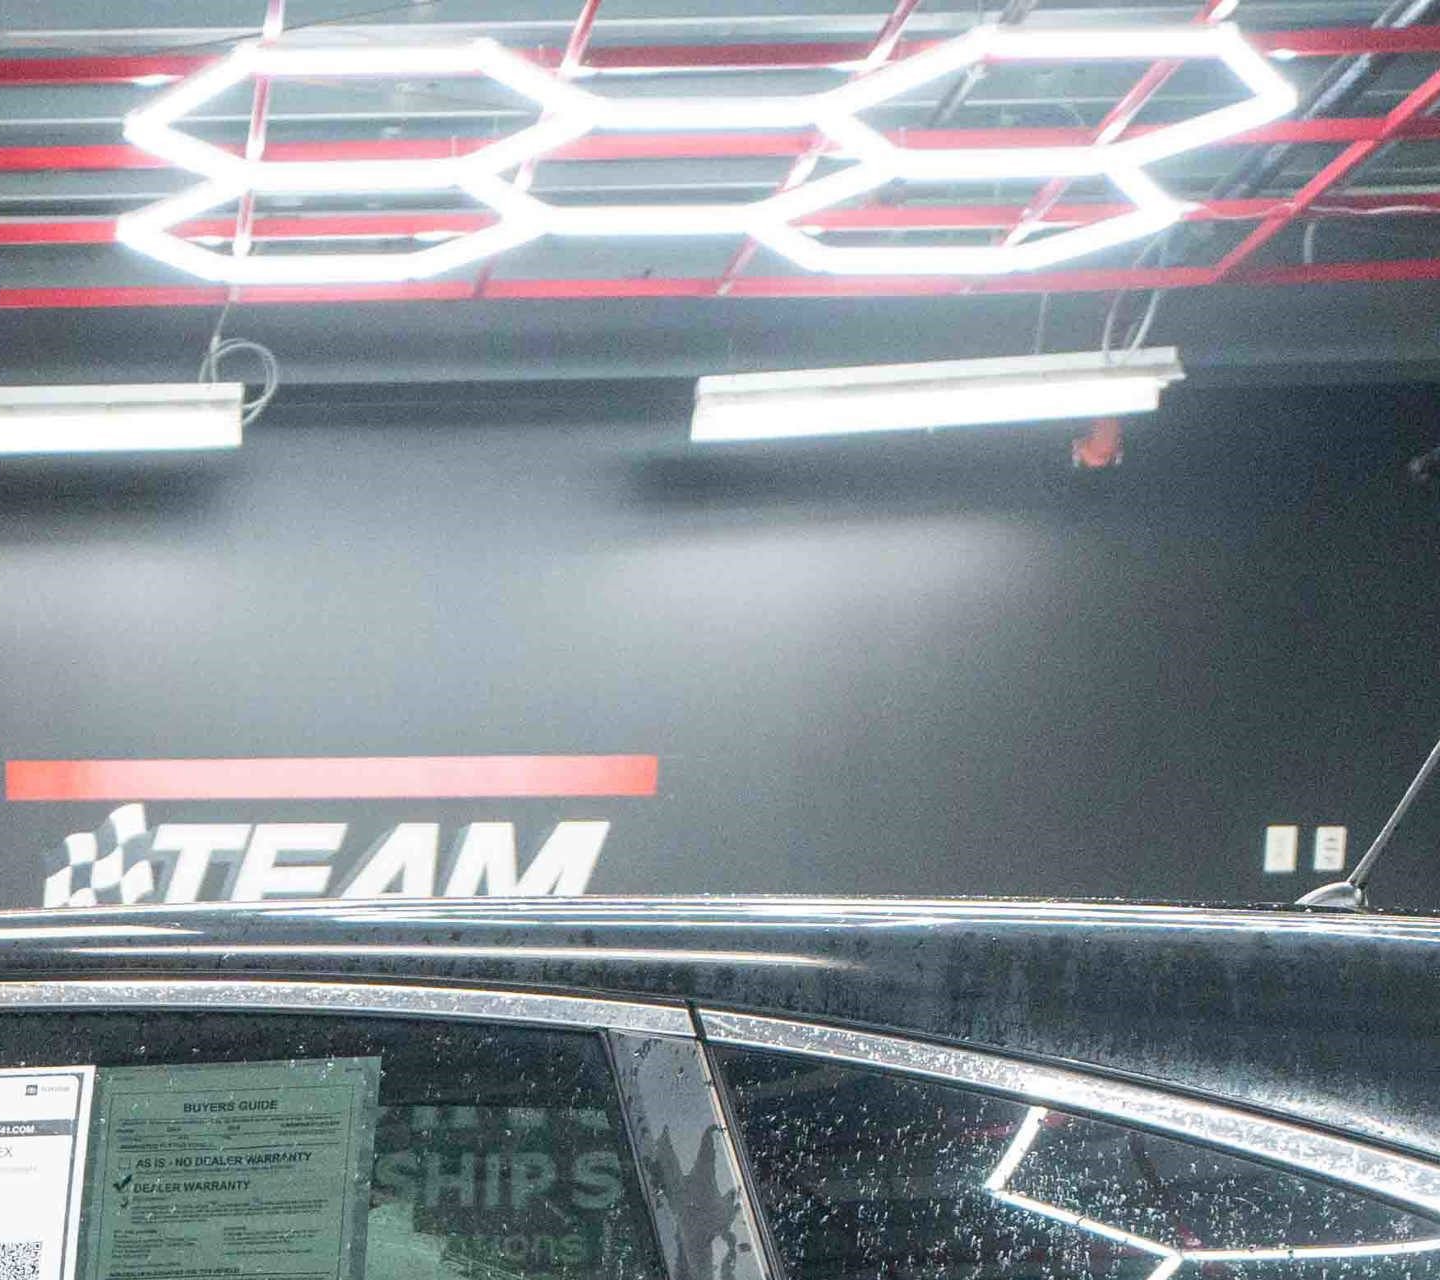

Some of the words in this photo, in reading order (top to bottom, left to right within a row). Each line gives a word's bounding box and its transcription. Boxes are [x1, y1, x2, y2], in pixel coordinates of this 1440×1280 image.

[152, 821, 610, 903] TEAM
[183, 1101, 234, 1113] BUYERS
[238, 1100, 278, 1112] GUIDE
[135, 1158, 151, 1169] AS
[154, 1158, 166, 1168] IS
[175, 1157, 192, 1168] NO
[195, 1155, 242, 1167] DEALER
[246, 1152, 312, 1165] WARRANTY
[134, 1183, 180, 1194] DEALER
[183, 1181, 251, 1192] WARRANTY
